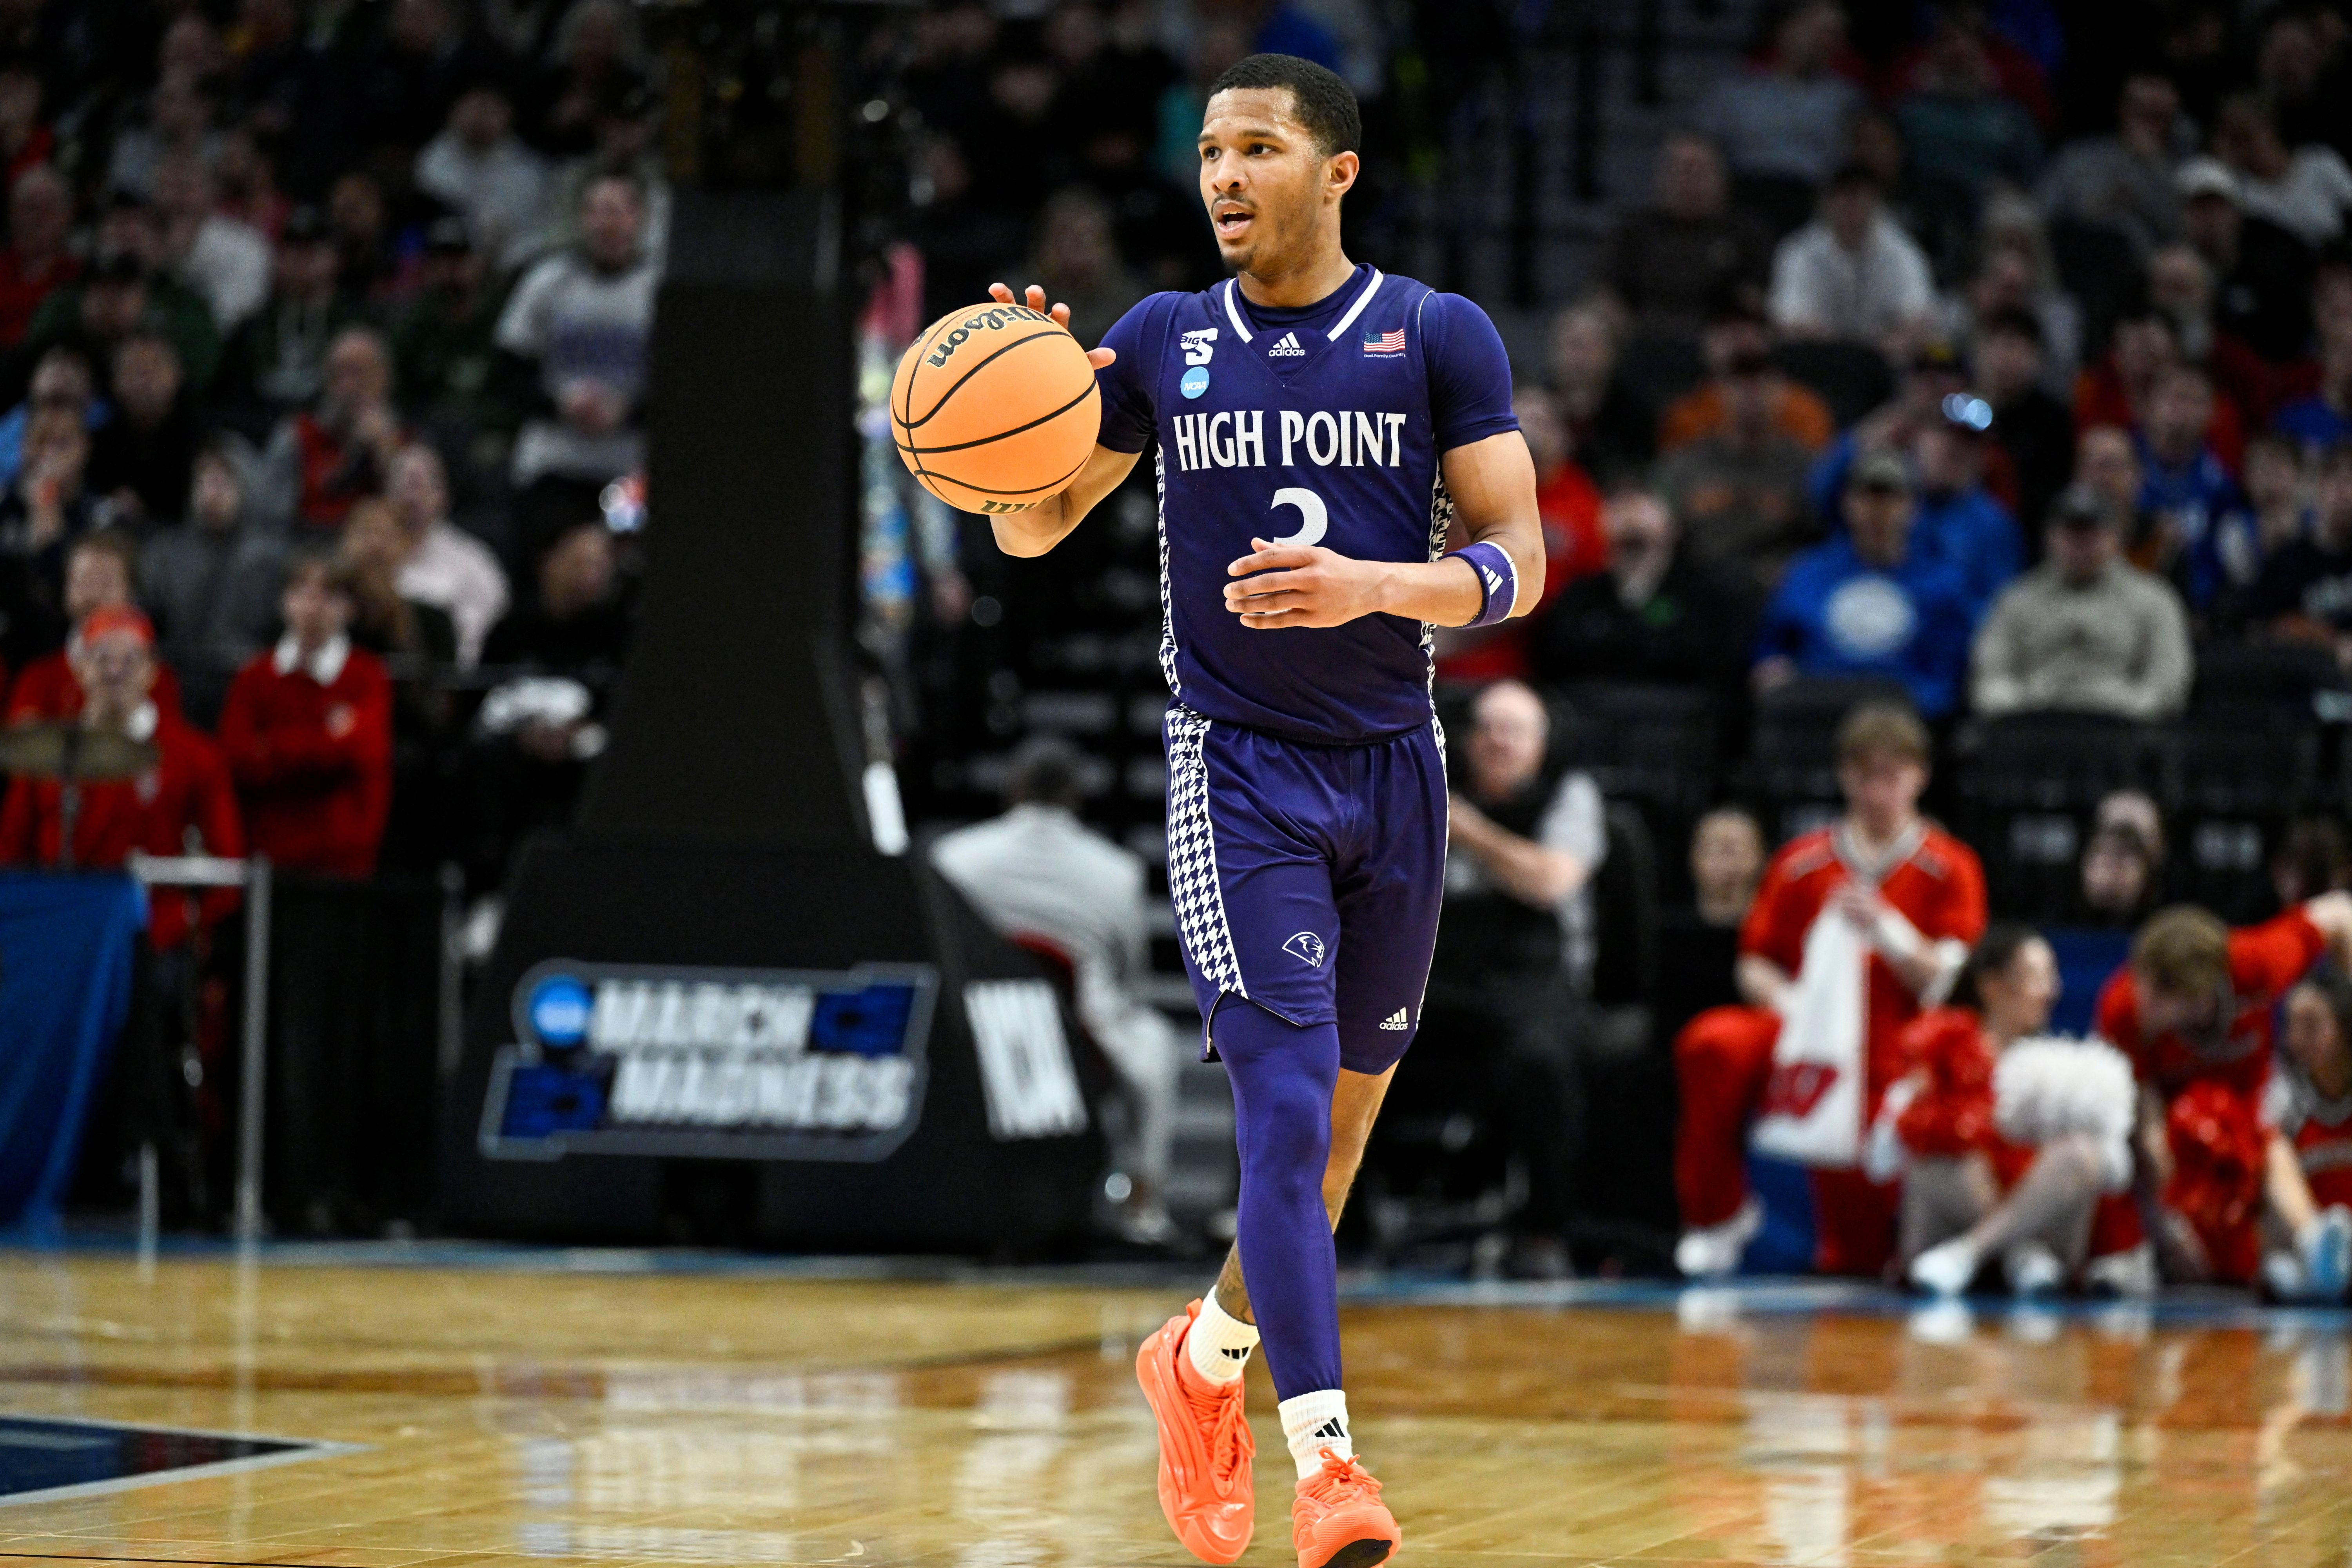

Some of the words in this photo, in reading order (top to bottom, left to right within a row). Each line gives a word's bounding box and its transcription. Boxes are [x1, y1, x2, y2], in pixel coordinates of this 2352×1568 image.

[926, 307, 1054, 368] Wilson
[1269, 347, 1305, 357] adidas
[1184, 381, 1206, 391] NCAA
[1173, 410, 1267, 471] HIGH
[1279, 410, 1407, 467] POINT
[1379, 1021, 1408, 1031] adidas
